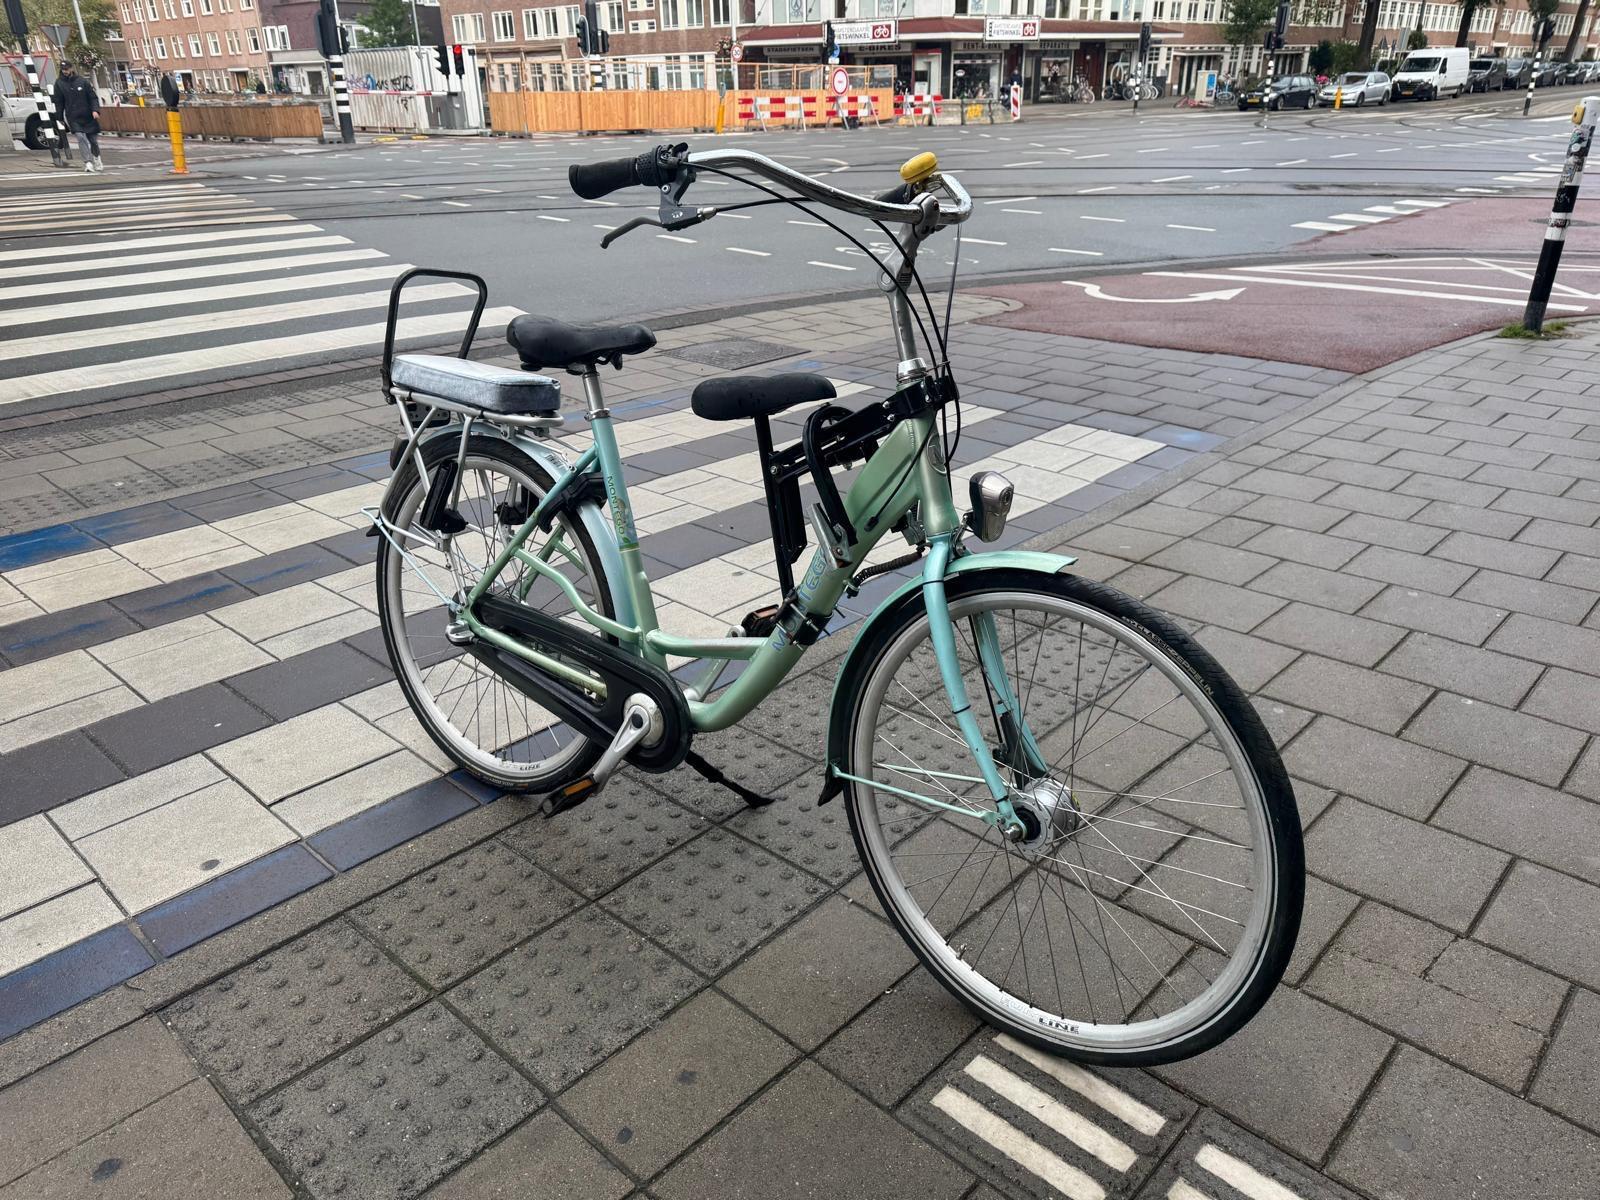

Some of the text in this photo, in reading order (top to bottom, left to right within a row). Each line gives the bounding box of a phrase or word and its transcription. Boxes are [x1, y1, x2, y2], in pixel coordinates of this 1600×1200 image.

[608, 476, 625, 535] MONTEGO
[1171, 651, 1215, 697] ZEPPELIN
[1039, 1017, 1080, 1036] LINE
